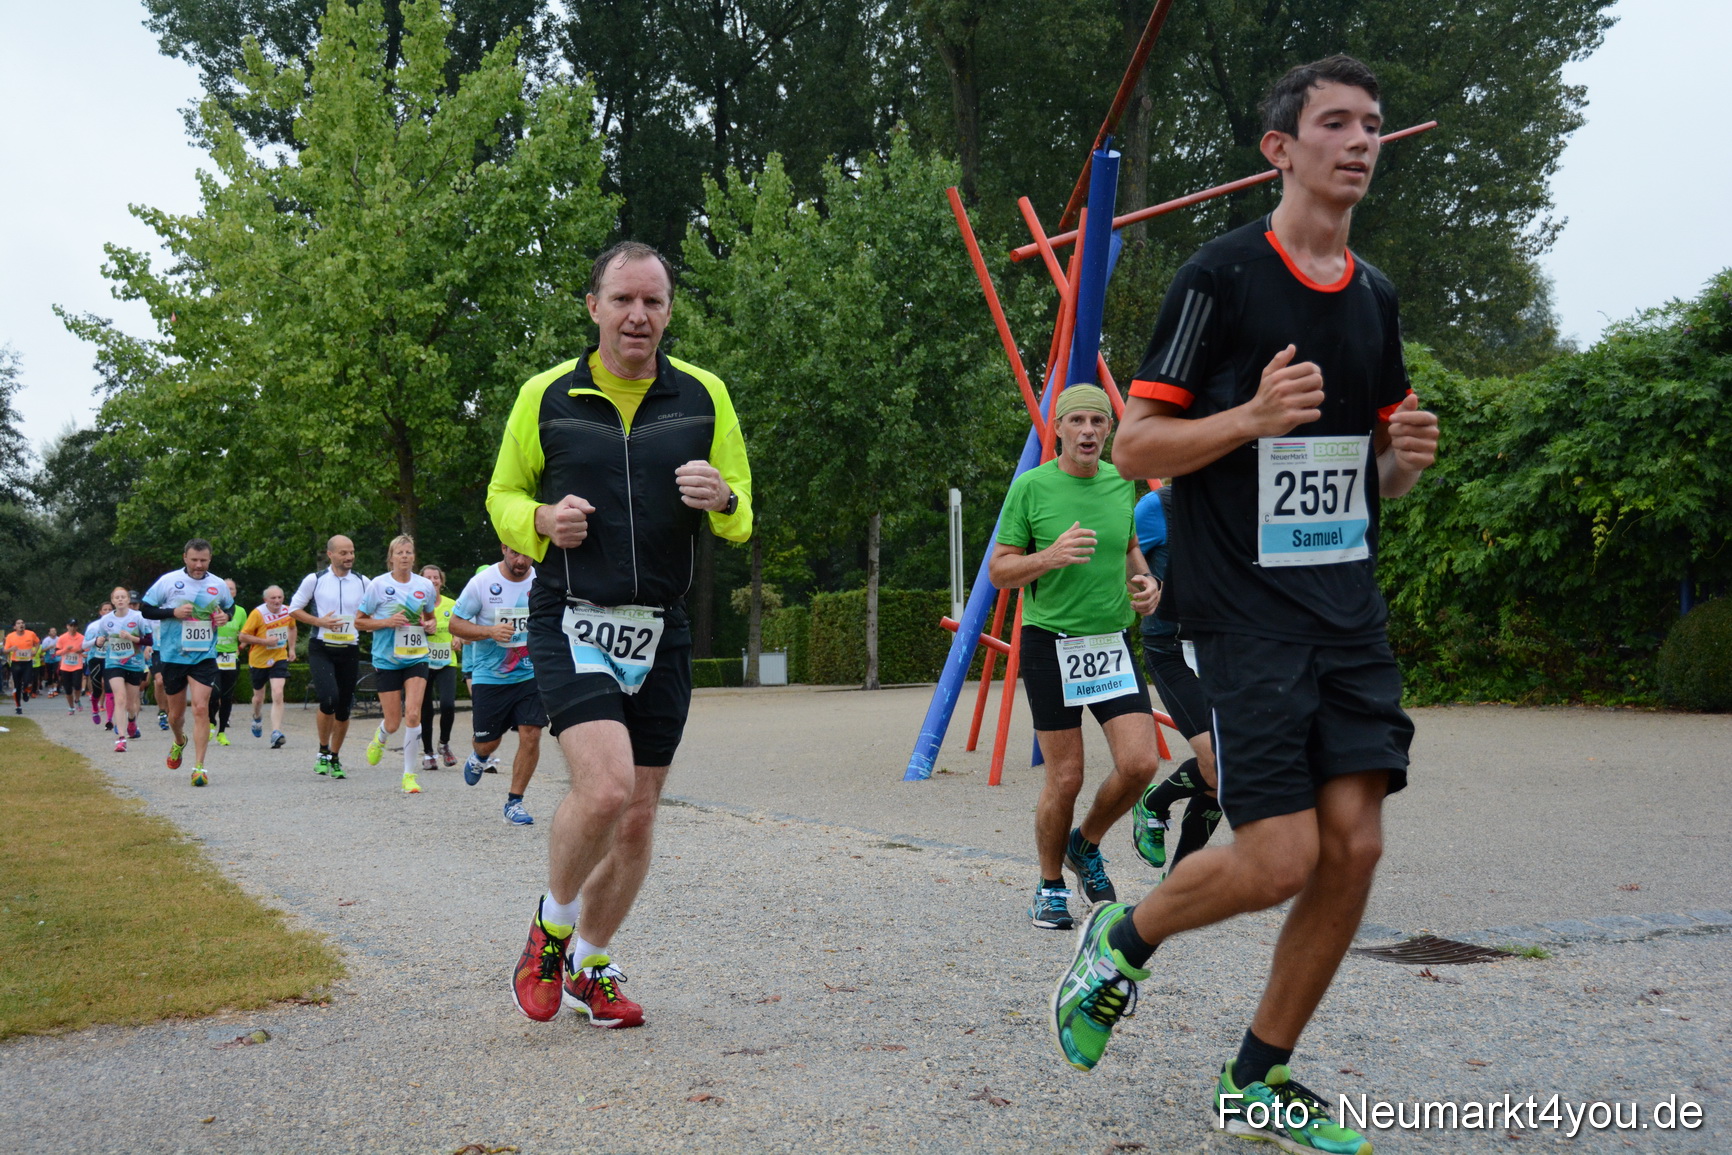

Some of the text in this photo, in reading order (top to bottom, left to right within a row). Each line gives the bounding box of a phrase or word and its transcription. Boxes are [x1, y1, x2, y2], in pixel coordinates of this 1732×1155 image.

[658, 412, 678, 420] CRAFT
[1313, 441, 1360, 458] BOCK
[1270, 453, 1308, 461] NeuerMarkt
[1273, 469, 1358, 517] 2557
[1292, 527, 1344, 548] Samuel
[185, 628, 211, 640] 3031
[403, 633, 422, 646] 198
[574, 619, 653, 661] 2052
[1089, 635, 1121, 646] BOCK
[110, 642, 132, 652] 2300
[1066, 649, 1123, 680] 2827
[1076, 680, 1123, 696] Alexander
